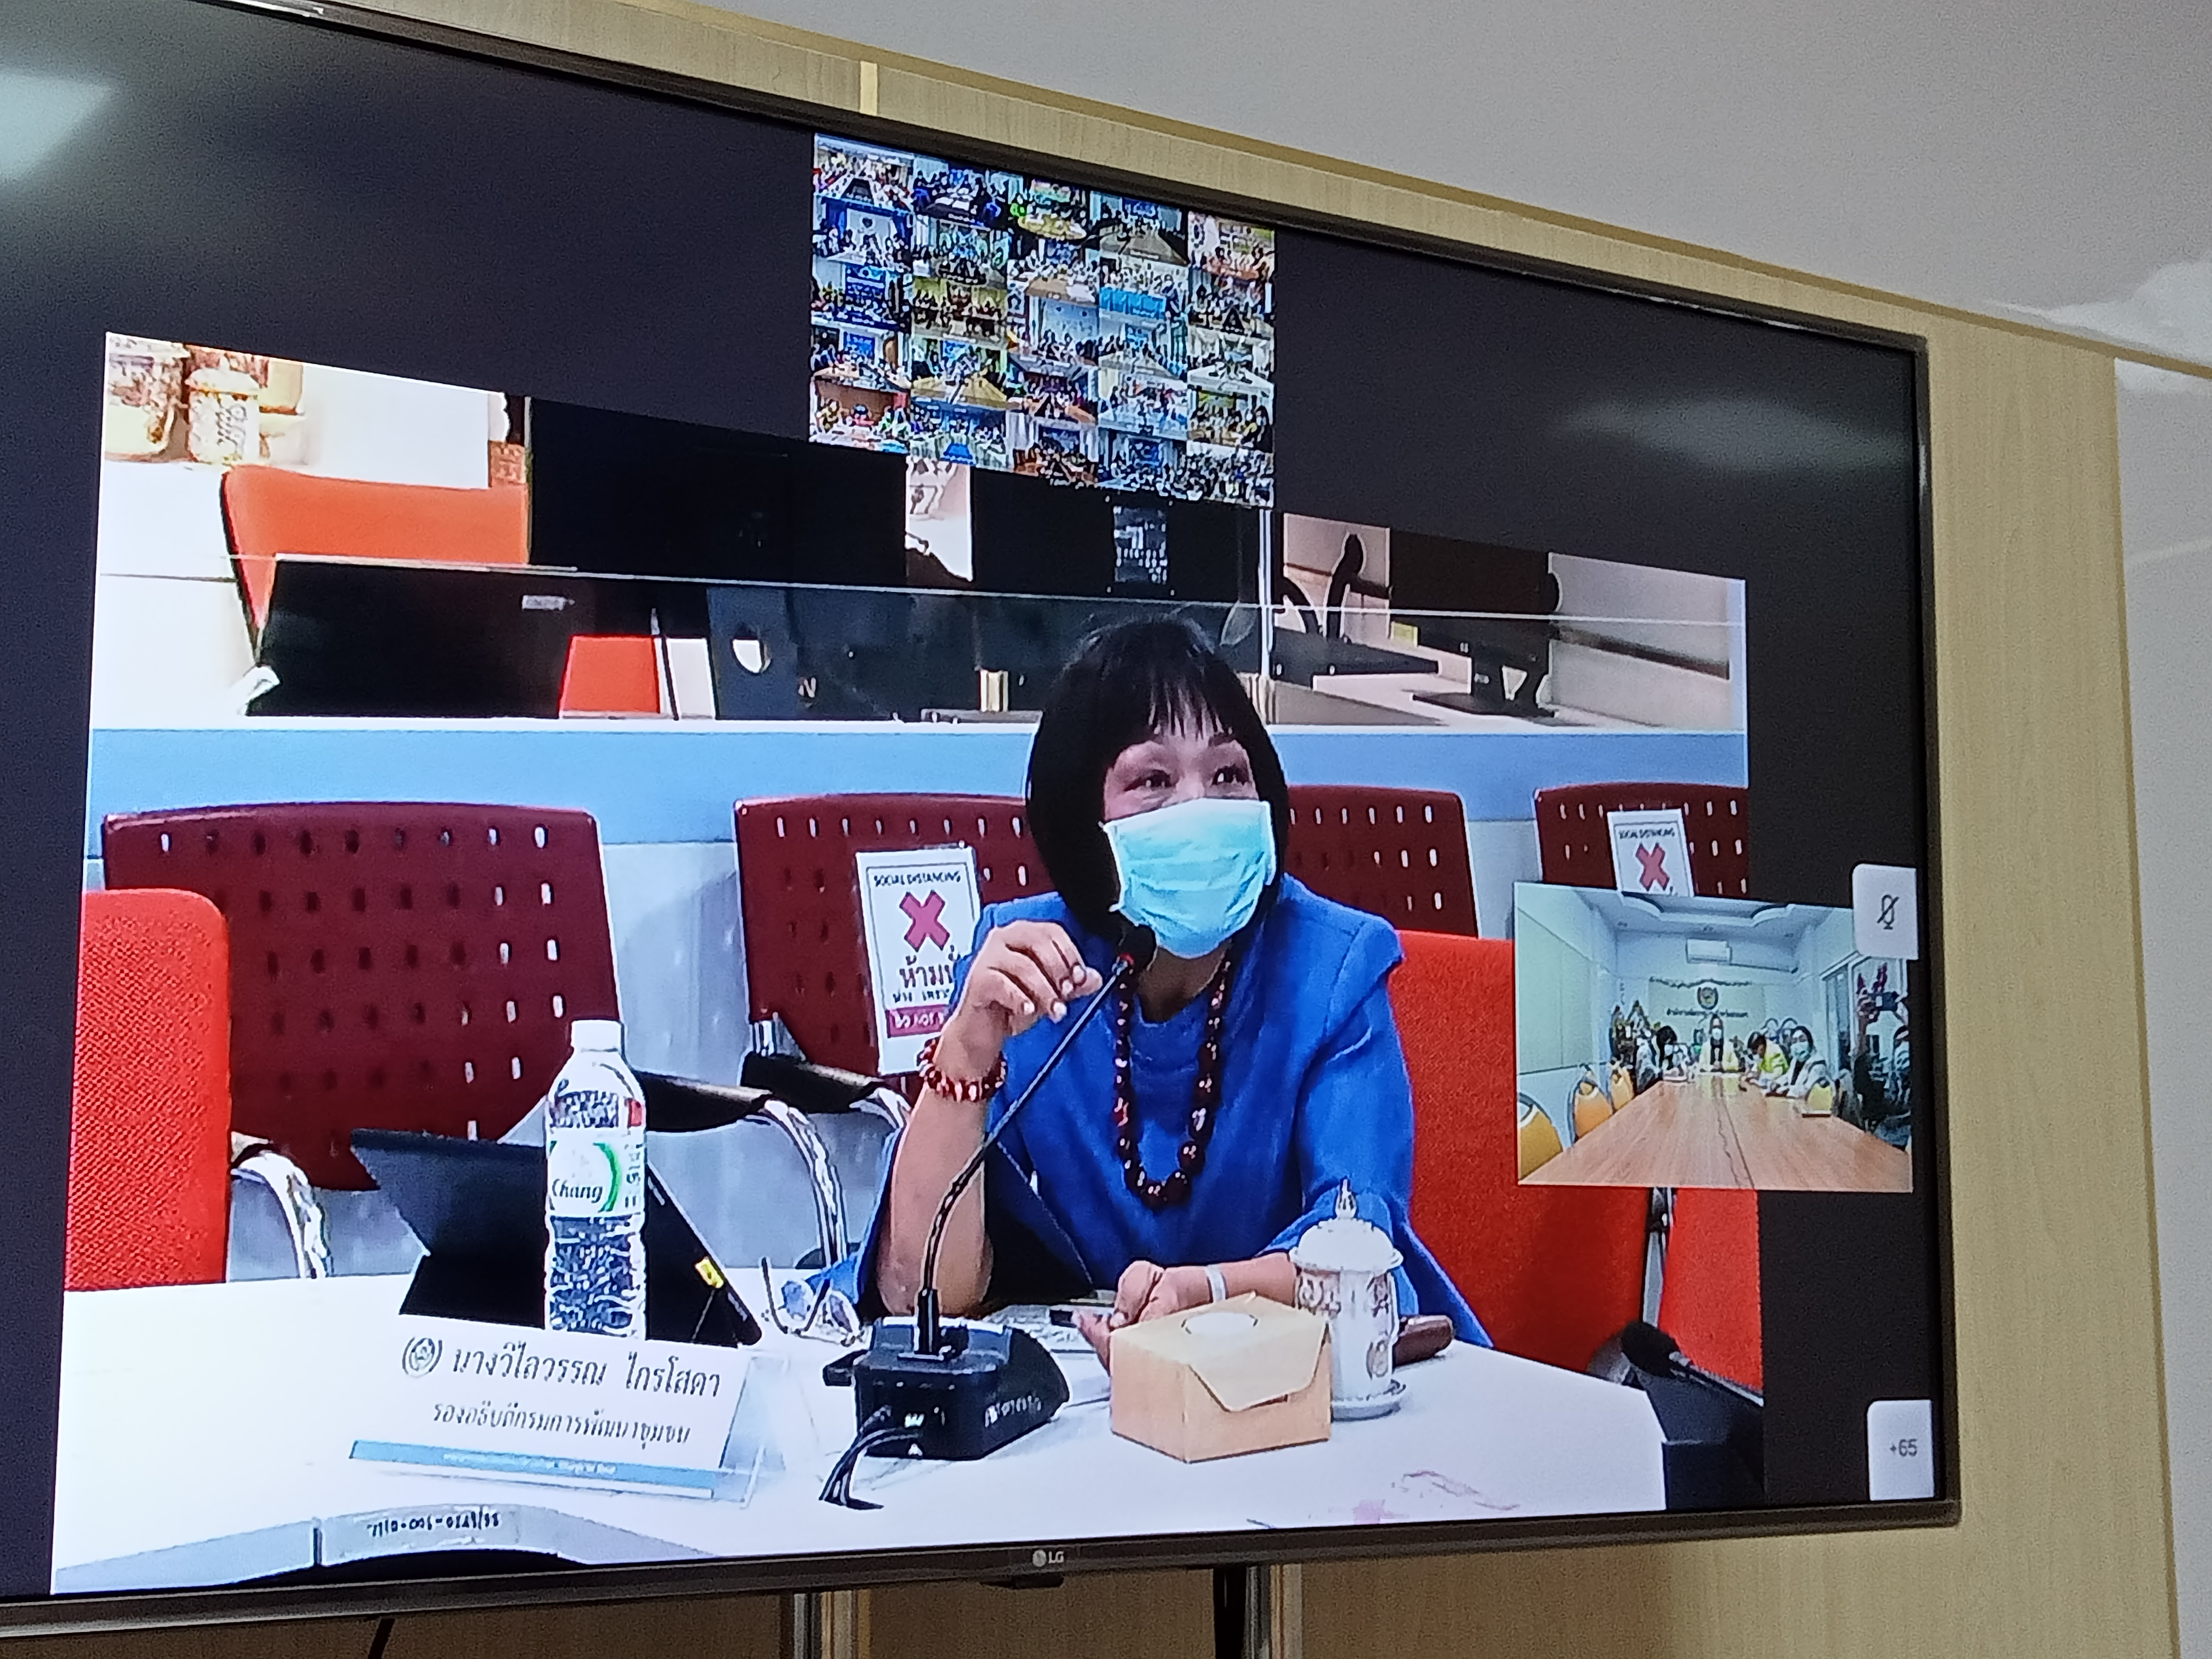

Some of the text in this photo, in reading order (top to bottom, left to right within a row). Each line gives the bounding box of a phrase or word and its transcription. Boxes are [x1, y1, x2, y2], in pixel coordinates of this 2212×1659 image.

[552, 1178, 602, 1204] Chang
[453, 1340, 607, 1386] นางวิไลวรรณ
[1890, 1438, 1918, 1457] +65
